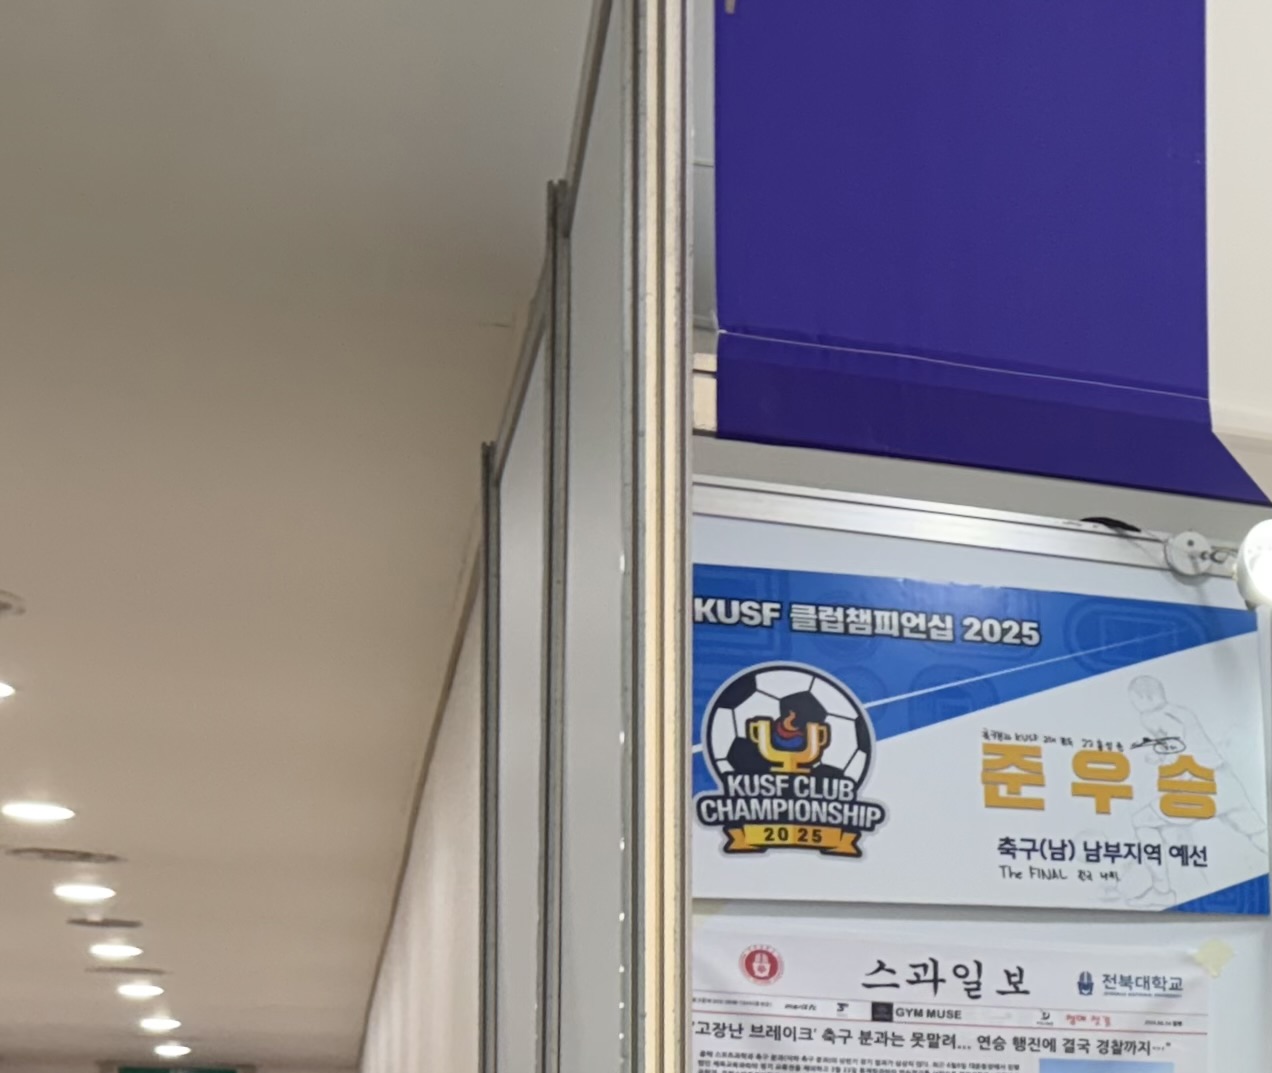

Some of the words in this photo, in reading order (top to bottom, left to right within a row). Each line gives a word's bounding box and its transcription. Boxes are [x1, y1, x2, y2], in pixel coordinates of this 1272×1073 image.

[694, 597, 781, 627] KUSF
[790, 602, 956, 643] 클럽챔피언십
[961, 616, 1041, 647] 2025
[727, 774, 790, 798] KUSF
[793, 775, 856, 801] CLUB
[700, 799, 883, 829] CHAMPIONSHIP
[764, 826, 823, 843] 2025
[997, 837, 1076, 862] 축구(남)
[1083, 840, 1162, 866] 남부지역
[1169, 844, 1208, 868] 예선
[999, 865, 1023, 880] The
[1029, 865, 1068, 881] FINAL
[861, 956, 1031, 1000] 스과일보
[1102, 972, 1184, 992] 전북대학교
[895, 1007, 924, 1019] GYM
[926, 1008, 962, 1020] MUSE
[749, 1023, 817, 1042] 브레이크'
[821, 1027, 853, 1046] 축구
[858, 1029, 906, 1048] 분과는
[977, 1035, 1007, 1051] 연승
[1012, 1036, 1057, 1053] 행진에
[1062, 1038, 1091, 1054] 결국
